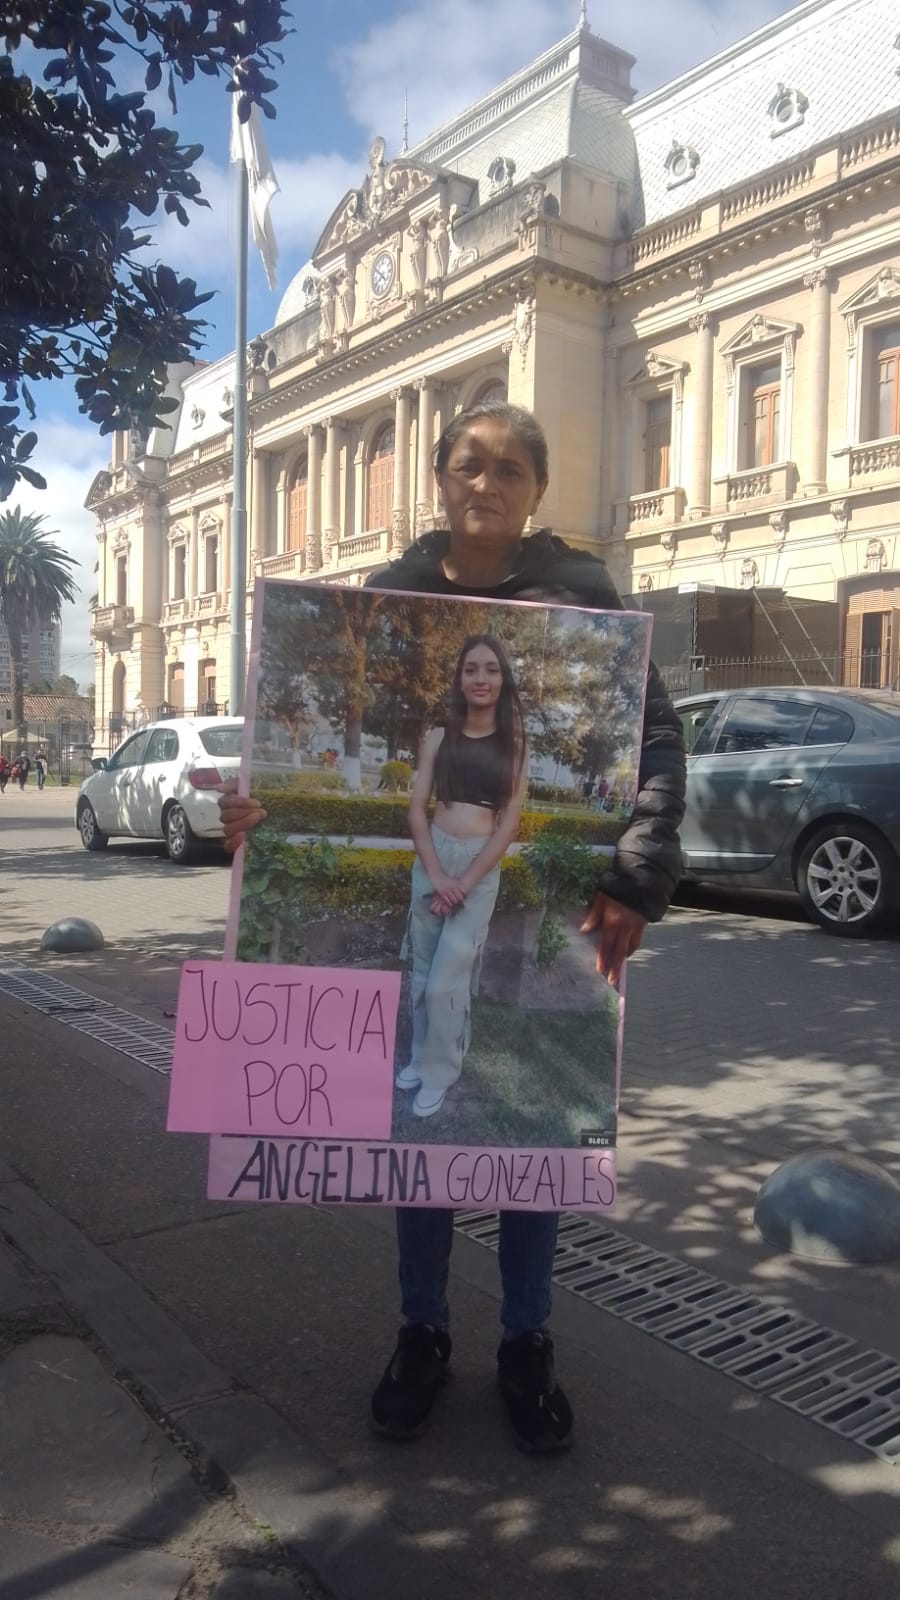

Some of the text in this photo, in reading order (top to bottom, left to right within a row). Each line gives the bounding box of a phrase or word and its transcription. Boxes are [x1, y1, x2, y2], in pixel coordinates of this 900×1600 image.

[185, 969, 387, 1060] JUSTICIA
[244, 1060, 332, 1127] POR
[227, 1139, 615, 1206] ANGELINA GONZALES
